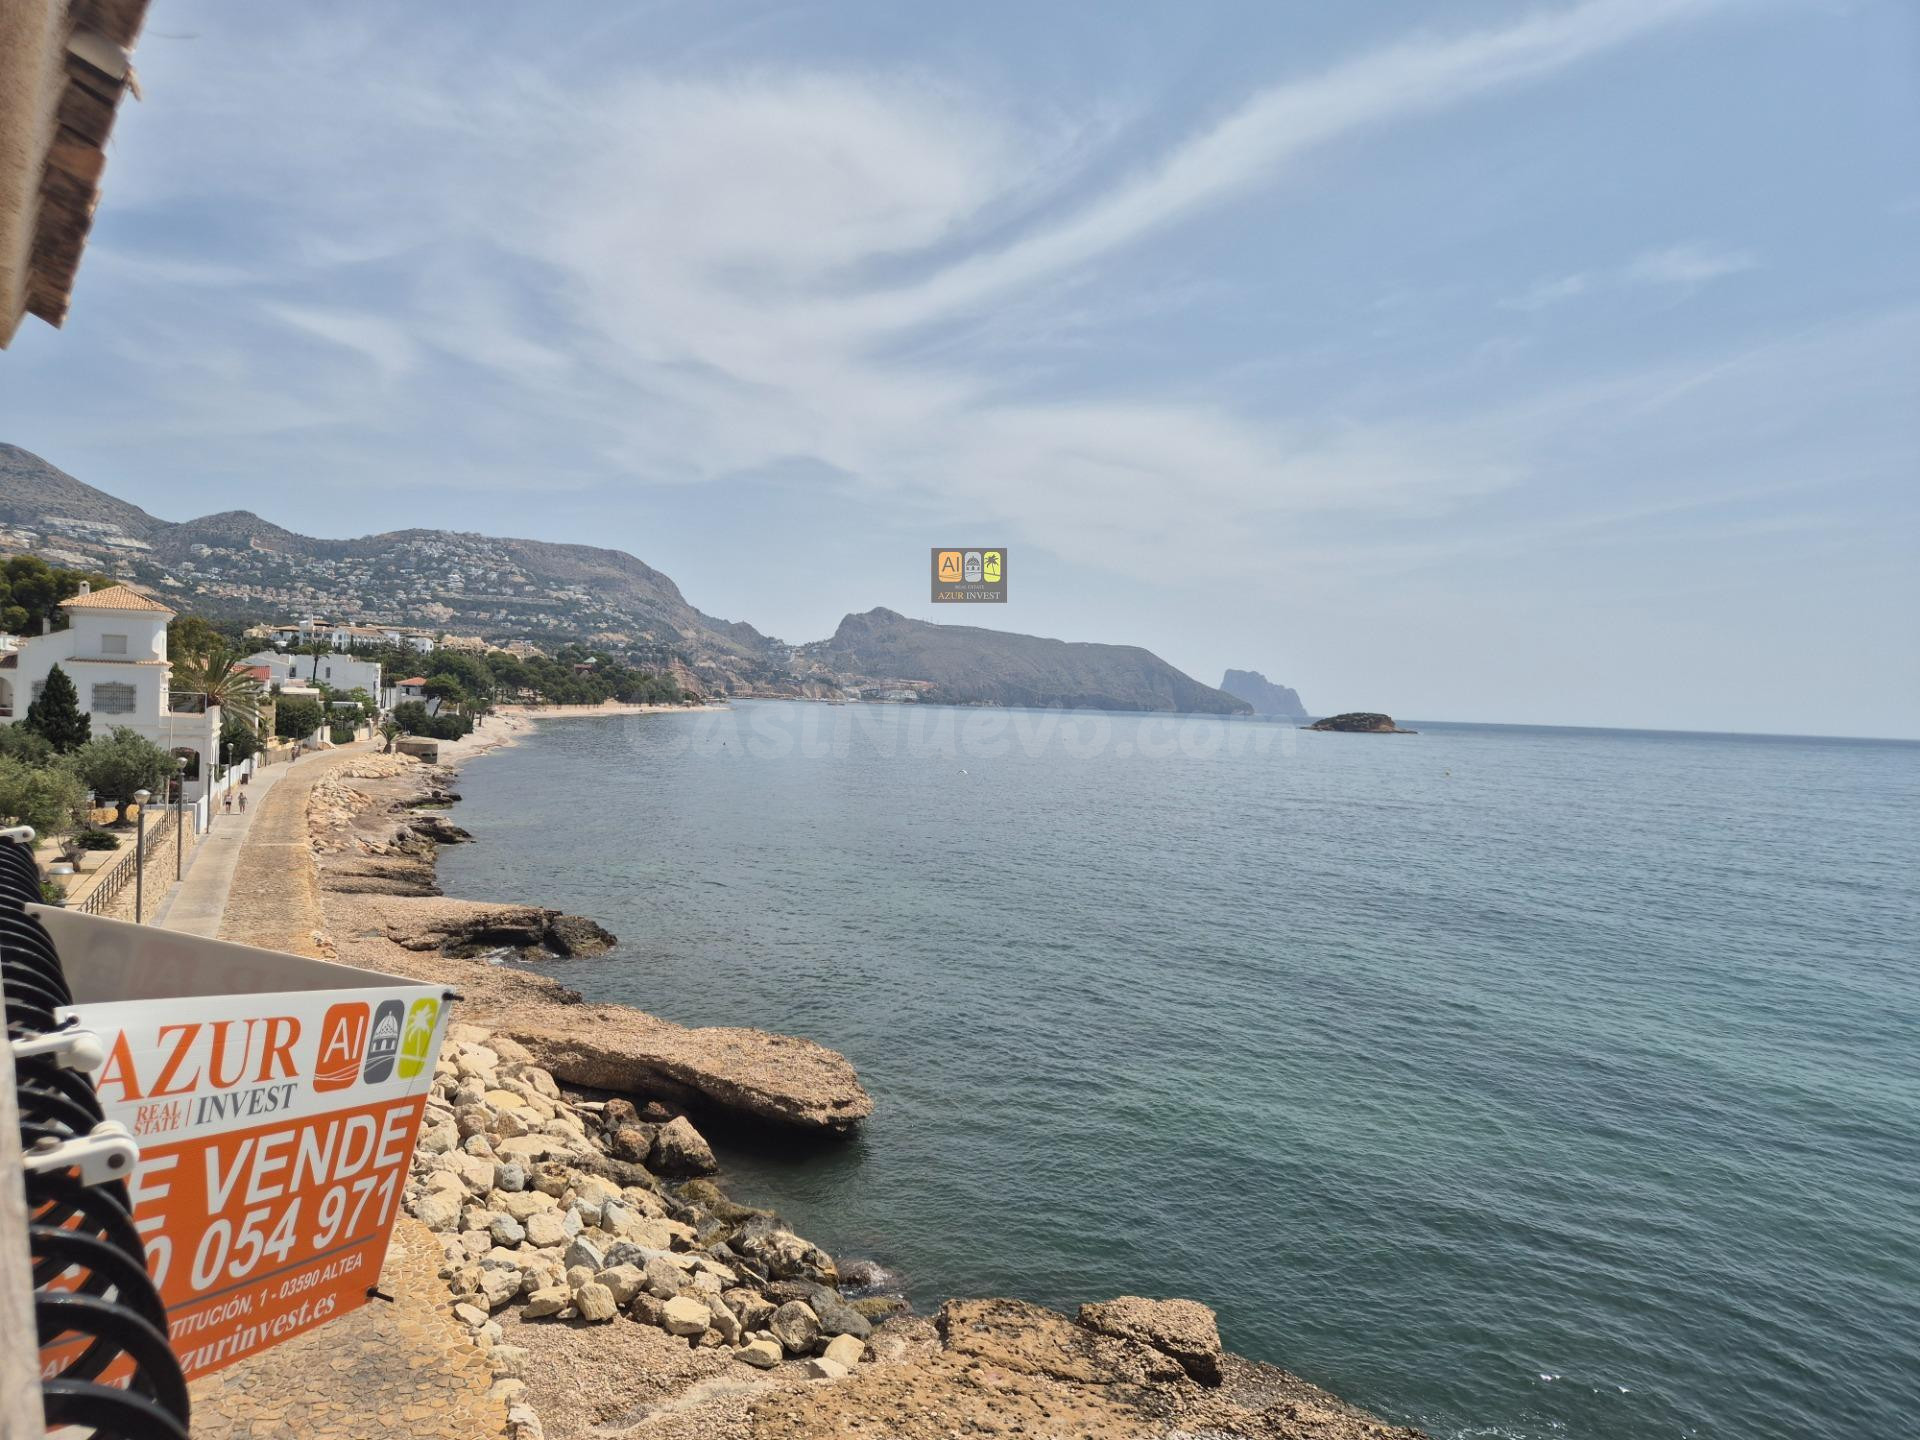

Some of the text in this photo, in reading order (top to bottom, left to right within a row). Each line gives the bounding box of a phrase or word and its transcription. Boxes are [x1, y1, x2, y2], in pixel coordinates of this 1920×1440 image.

[95, 1016, 302, 1103] AZUR
[134, 1114, 181, 1137] STATE
[136, 1101, 181, 1122] REAL
[195, 1083, 298, 1125] INVEST
[205, 1105, 415, 1215] VENDE
[190, 1197, 302, 1291] 054
[313, 1168, 399, 1249] 971
[170, 1294, 253, 1341] TITUCIÓN,
[260, 1288, 269, 1307] 1
[279, 1269, 320, 1300] 03590
[321, 1252, 363, 1282] ALTEA
